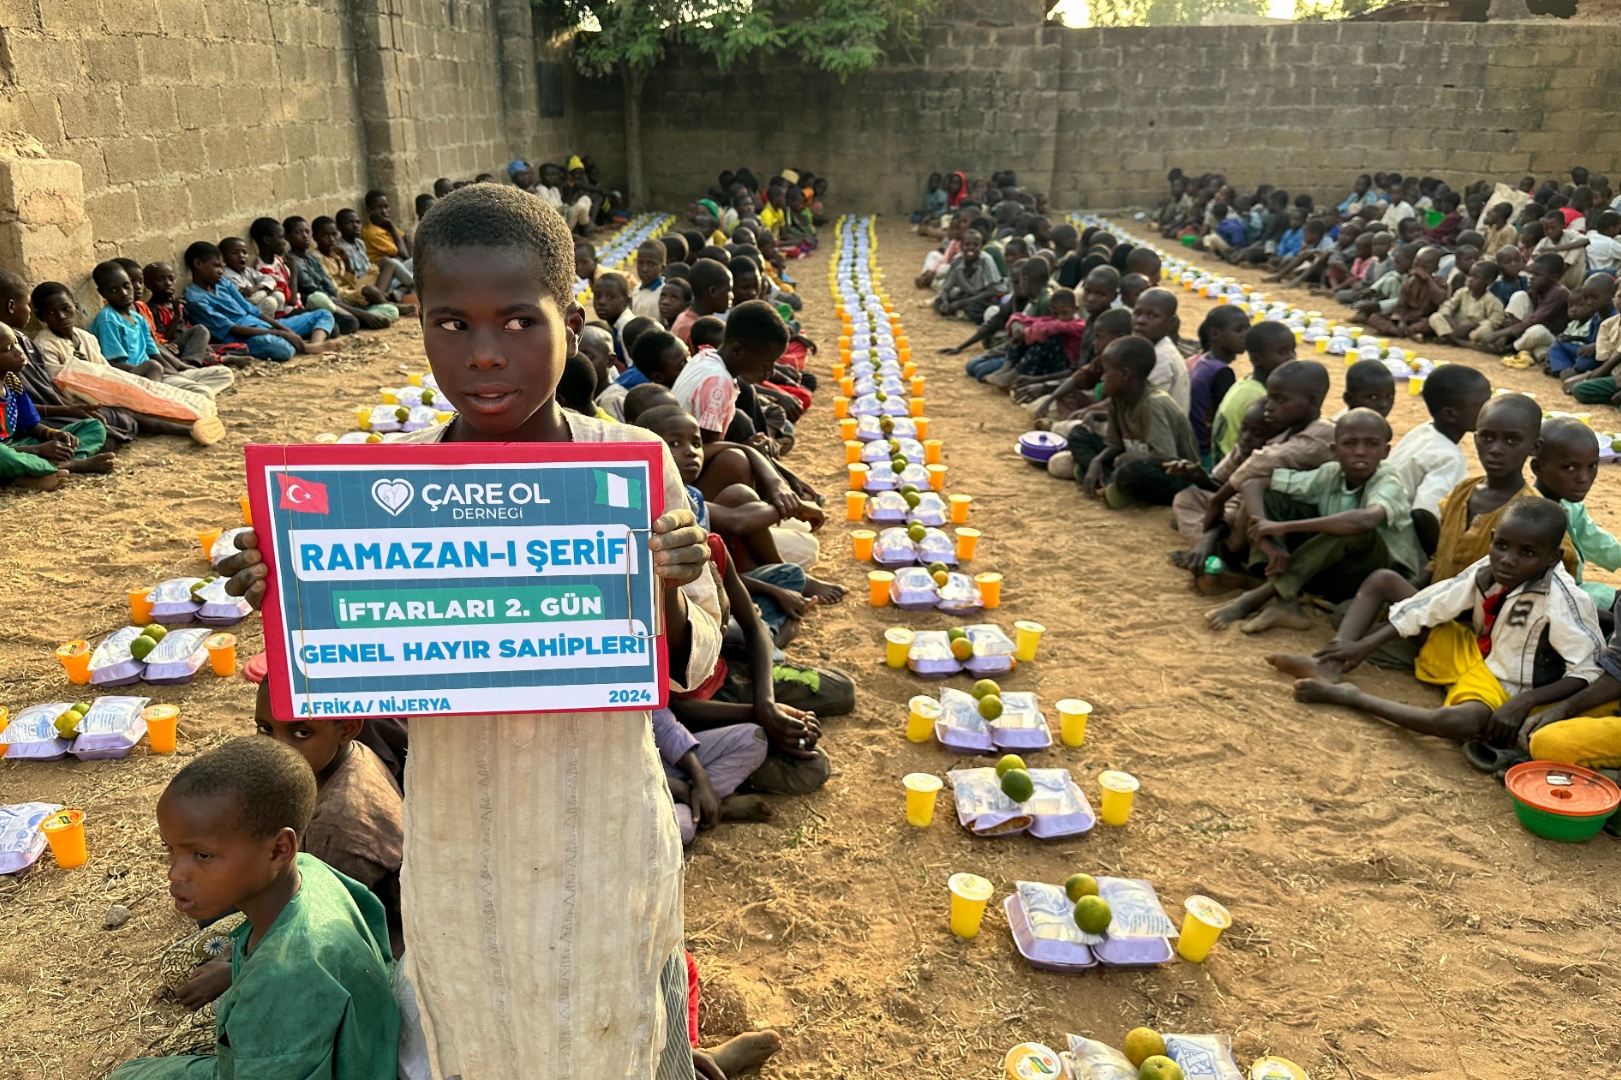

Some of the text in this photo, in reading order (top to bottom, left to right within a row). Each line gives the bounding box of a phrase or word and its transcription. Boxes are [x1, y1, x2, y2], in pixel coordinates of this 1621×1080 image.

[421, 483, 551, 512] ÇARE OL
[300, 530, 627, 573] RAMAZAN-I ŞERİF
[339, 592, 602, 621] İFTARLARI 2. GÜN
[299, 632, 646, 664] GENEL HAYIR SAHİPLERİ
[379, 695, 451, 712] NİJERYA
[609, 690, 651, 704] 2024
